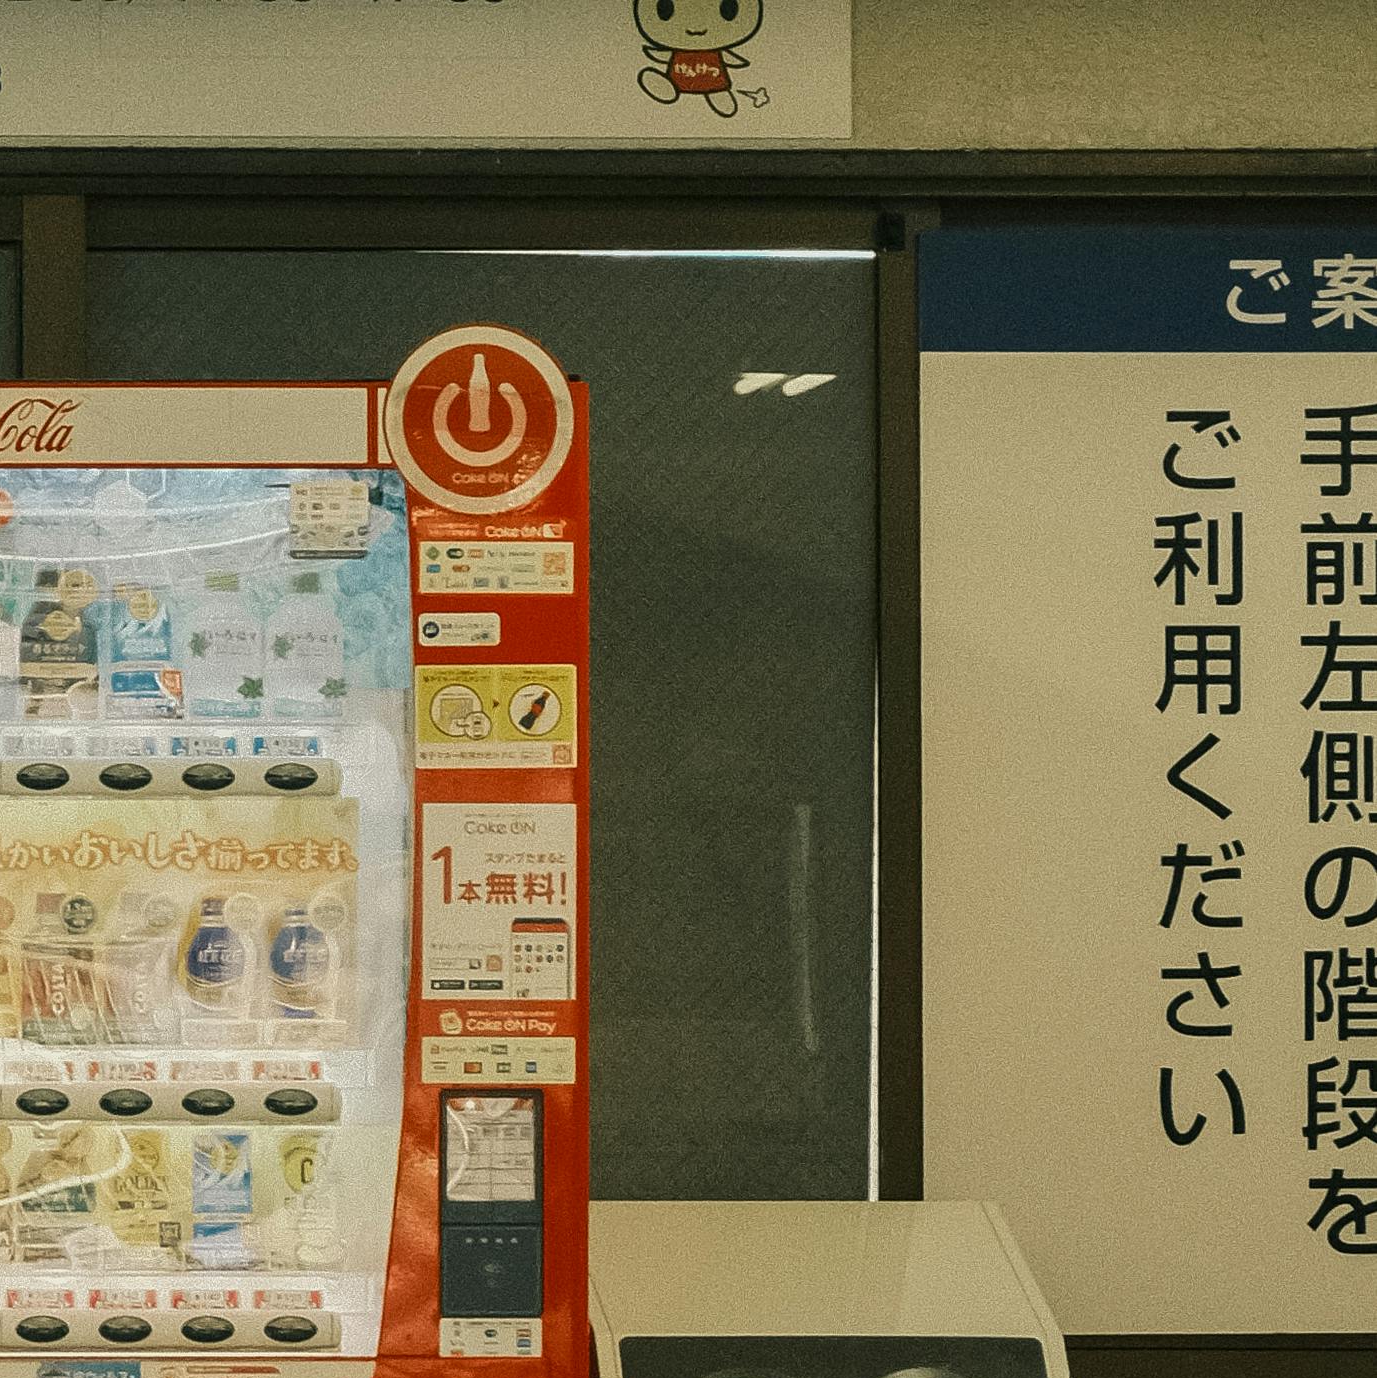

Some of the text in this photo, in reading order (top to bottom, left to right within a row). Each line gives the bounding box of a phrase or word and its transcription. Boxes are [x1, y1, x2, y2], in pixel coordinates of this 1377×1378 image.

[431, 846, 568, 905] 1本無料!
[464, 820, 537, 834] Coke ON
[1153, 409, 1245, 1146] ご利用ください
[1300, 405, 1377, 1256] 手前左側の階段を
